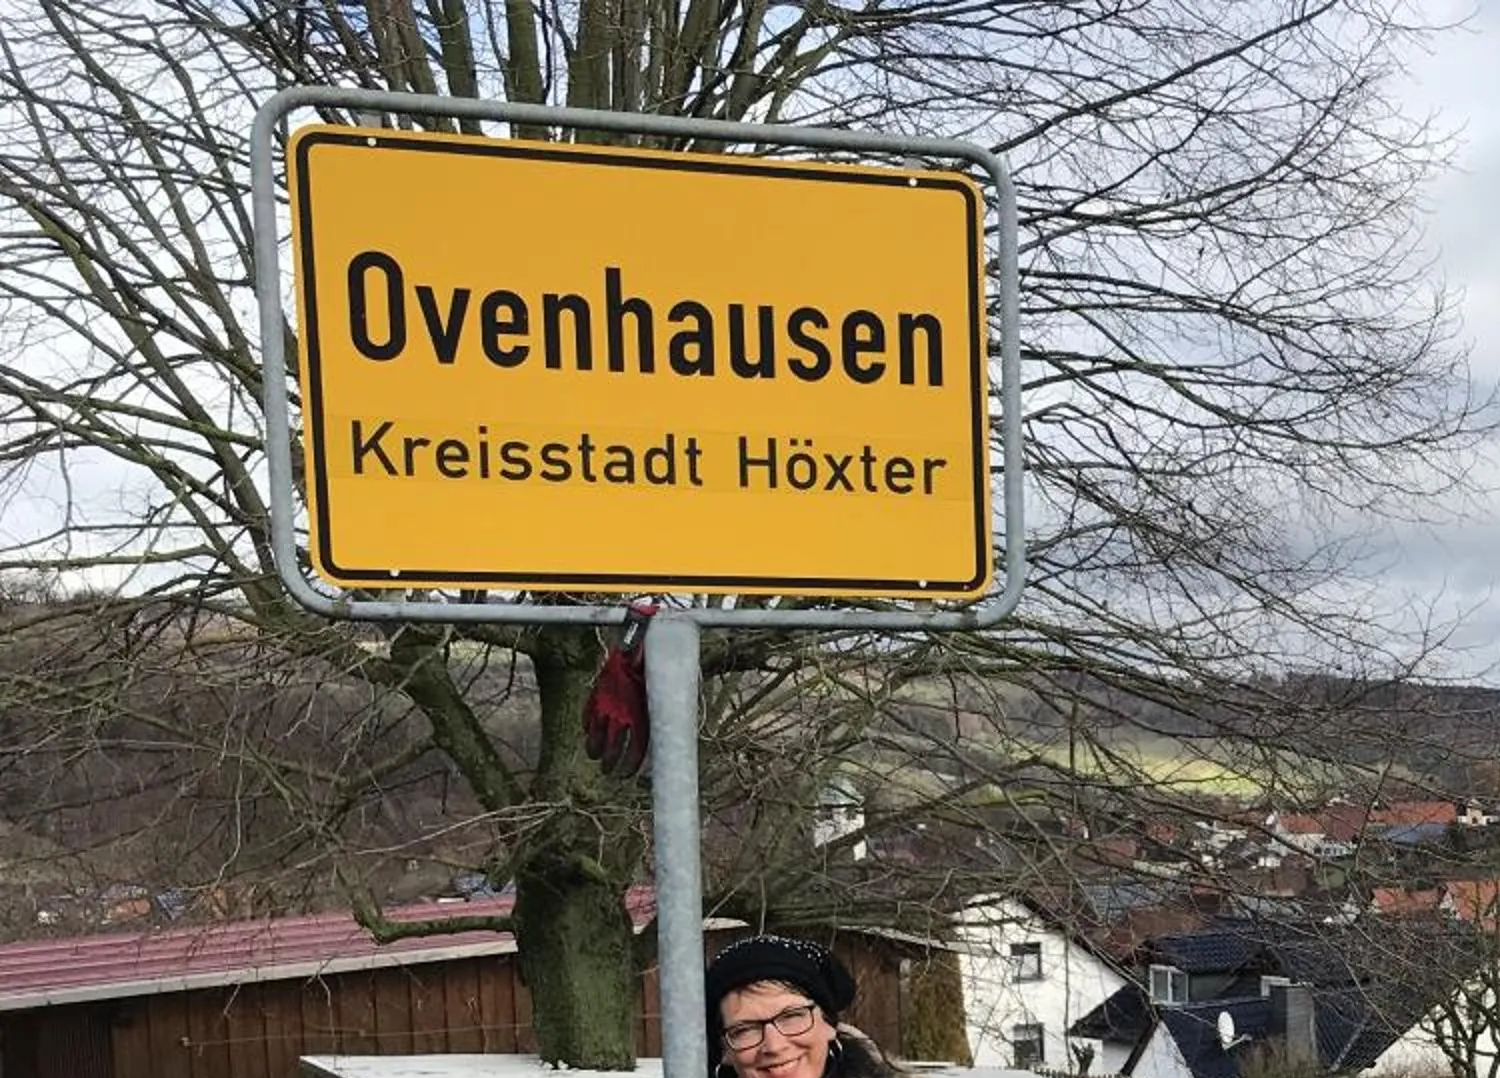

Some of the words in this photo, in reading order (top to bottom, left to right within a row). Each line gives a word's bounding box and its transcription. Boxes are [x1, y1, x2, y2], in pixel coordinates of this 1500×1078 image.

[348, 251, 943, 387] Ovenhausen
[351, 420, 704, 486] Kreisstadt
[739, 436, 947, 495] Höxter
